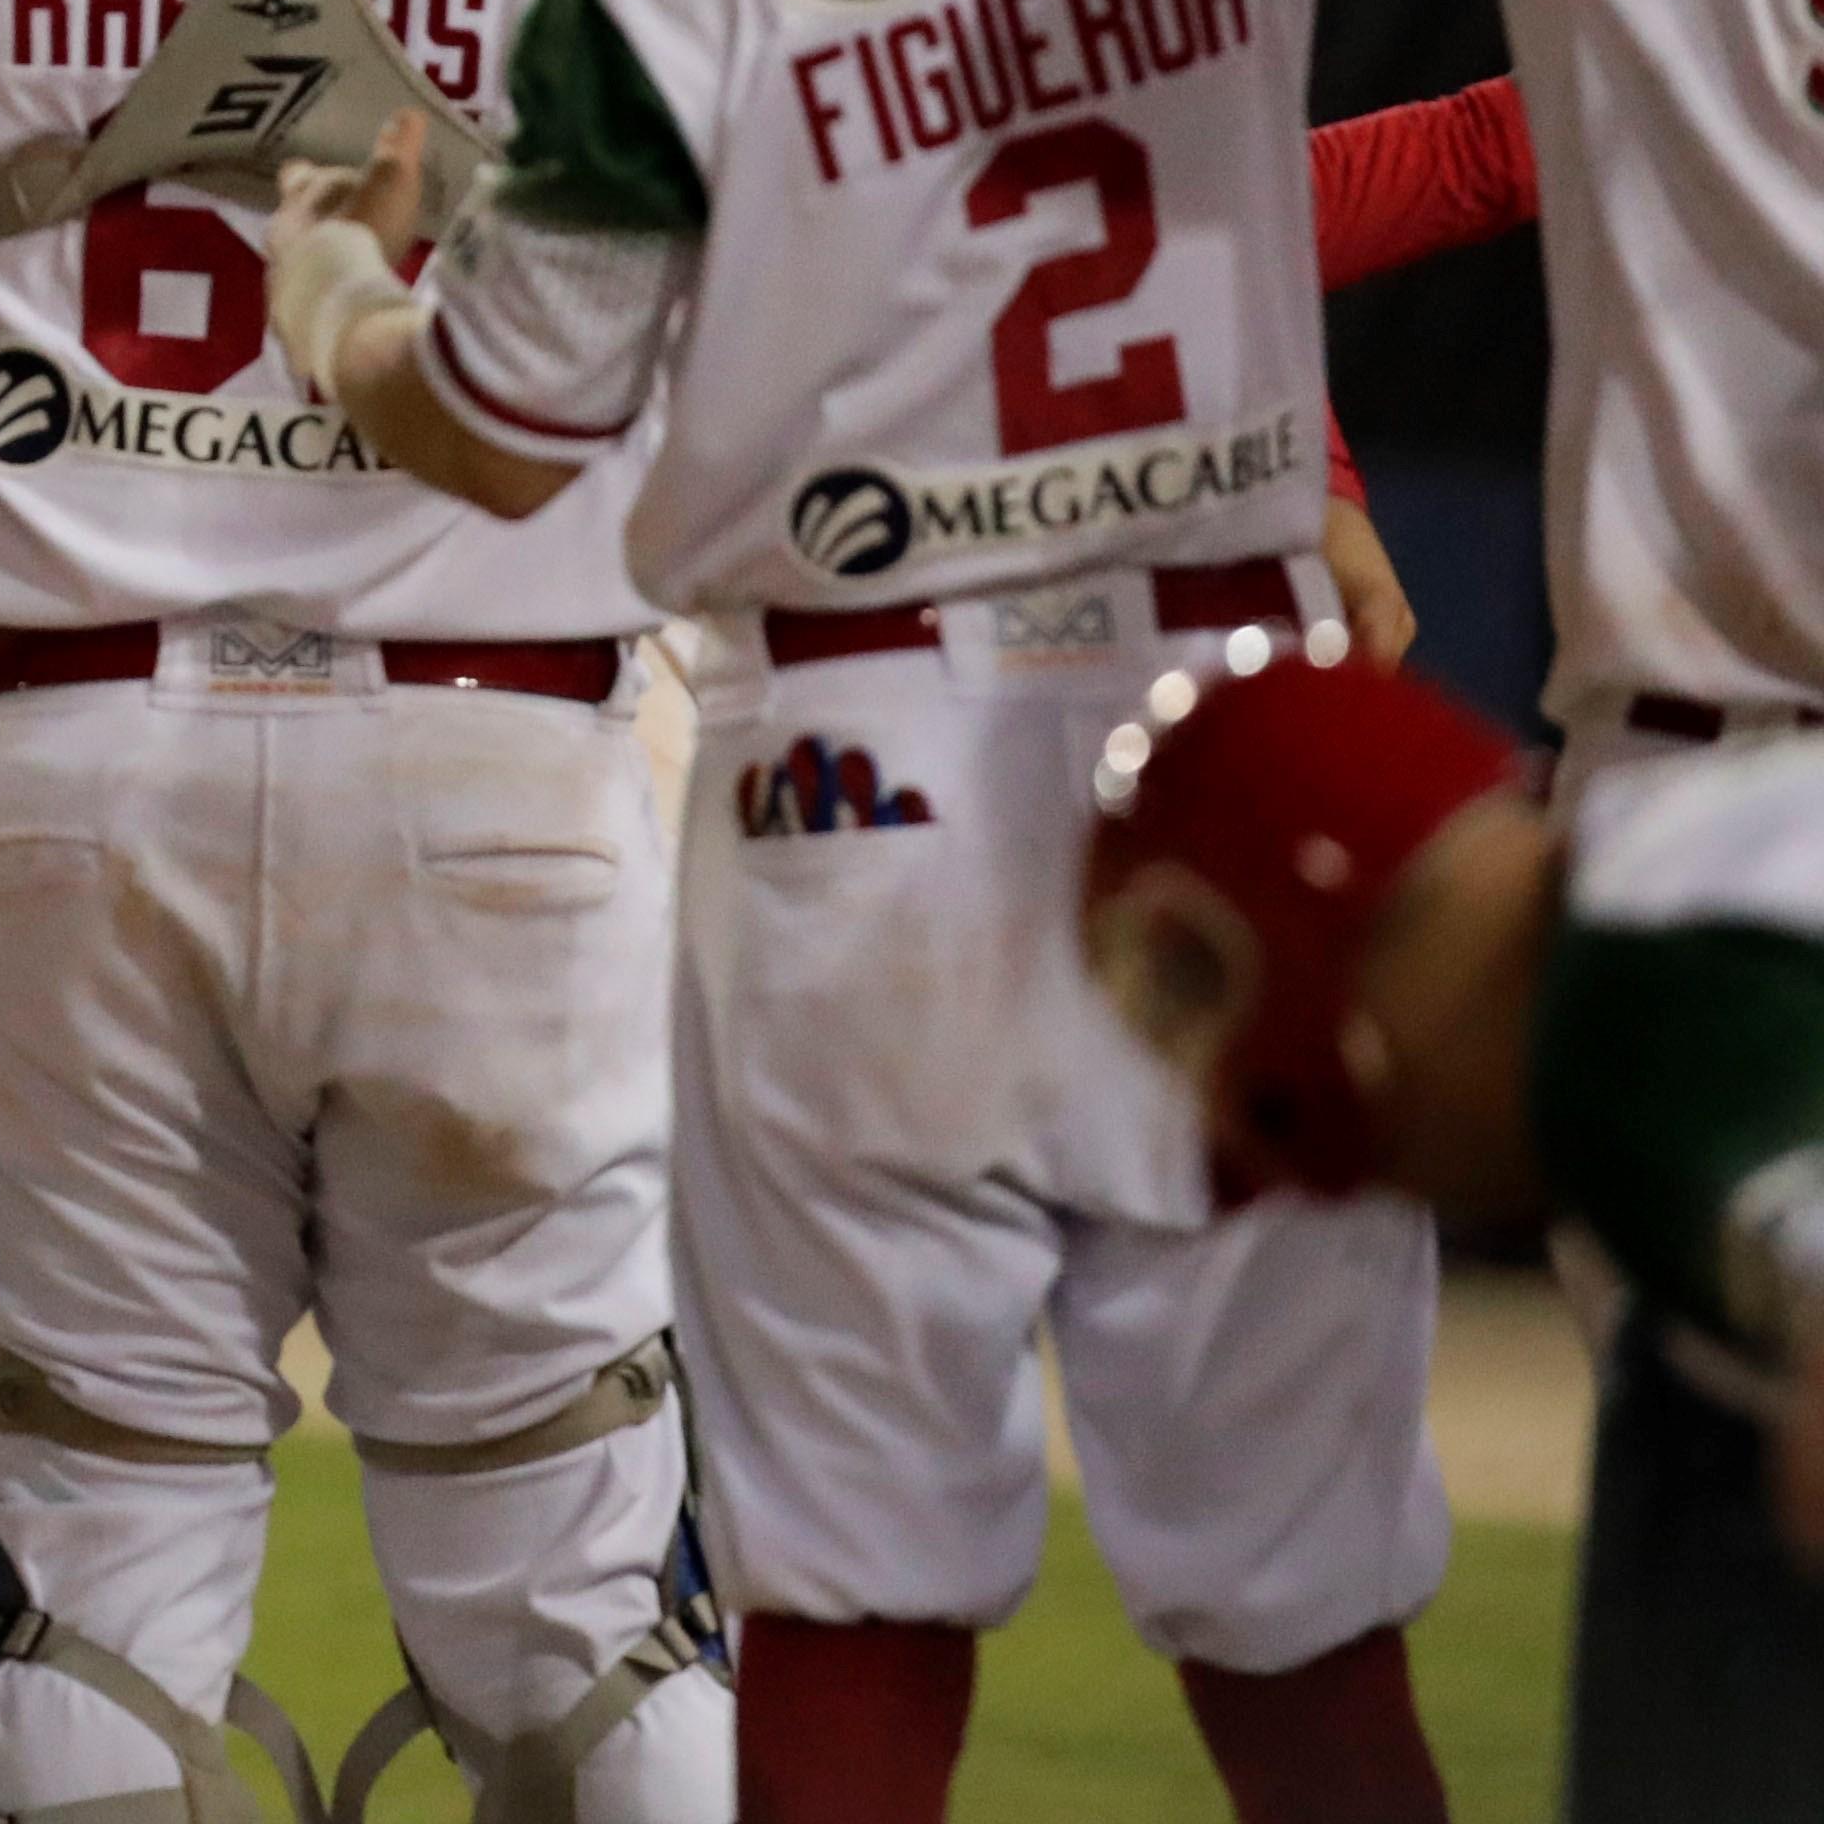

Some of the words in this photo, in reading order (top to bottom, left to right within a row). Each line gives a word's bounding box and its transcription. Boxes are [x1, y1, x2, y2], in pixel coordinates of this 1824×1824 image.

[964, 116, 1188, 459] 2
[70, 388, 396, 472] MEGACA
[914, 409, 1298, 543] MEGACABLE
